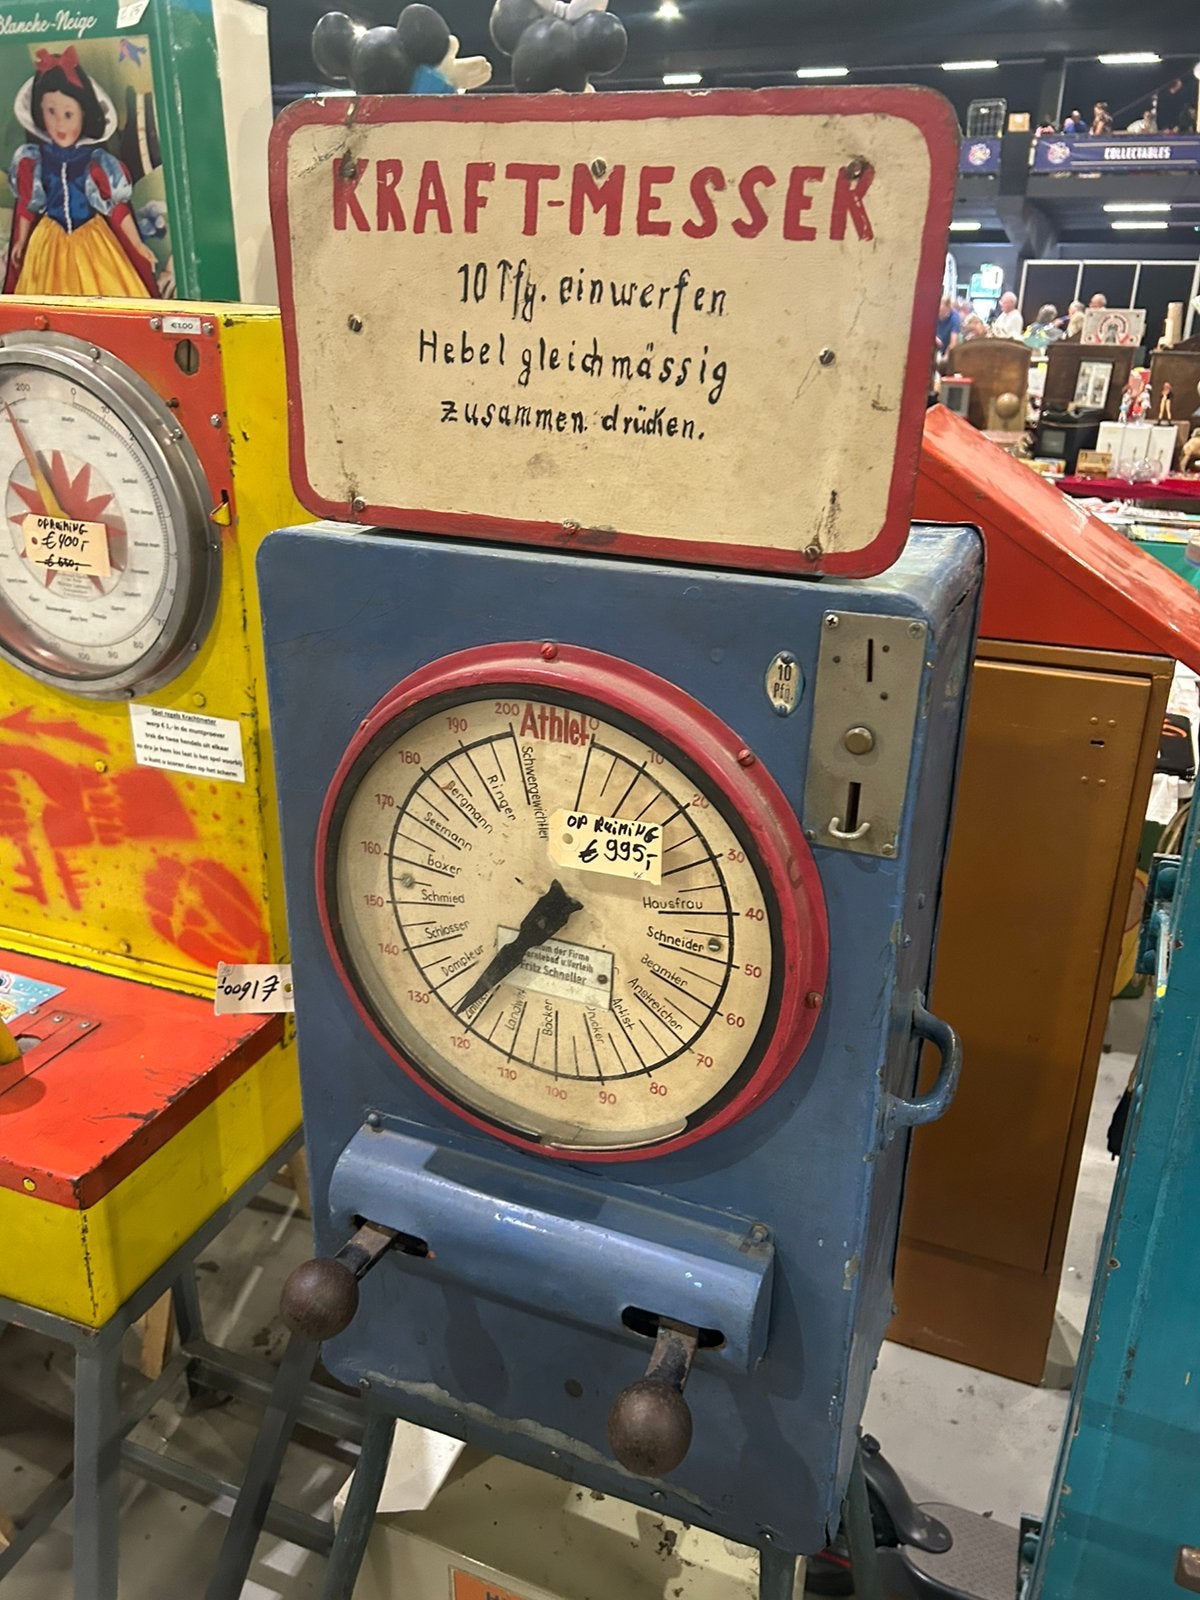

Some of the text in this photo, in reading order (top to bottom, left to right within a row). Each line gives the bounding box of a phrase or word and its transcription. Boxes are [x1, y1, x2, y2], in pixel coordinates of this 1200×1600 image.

[1104, 146, 1171, 159] COLLECTABLES
[332, 157, 876, 241] KRAFT-MESSER
[457, 261, 488, 304] 10
[559, 267, 728, 335] einwerfen
[419, 328, 728, 405] Hebel gleichmässig
[777, 664, 792, 682] 10
[495, 702, 520, 716] 200
[448, 717, 468, 733] 190
[520, 703, 589, 746] Athlet
[399, 751, 421, 765] 180
[648, 750, 665, 765] 10
[375, 794, 394, 809] 170
[487, 774, 516, 821] Ringer
[692, 794, 709, 809] 20
[567, 815, 588, 829] OP
[423, 811, 473, 852] Seemann
[361, 841, 381, 855] 160
[727, 849, 745, 863] 30
[427, 854, 462, 875] Boxer
[363, 894, 384, 907] 150
[421, 889, 465, 904] Schmied
[642, 896, 704, 910] Hausfrau
[745, 908, 765, 921] 40
[424, 919, 470, 940] Schlosser
[646, 925, 705, 953] Schneider
[378, 943, 399, 956] 140
[640, 953, 688, 987] Beamter
[744, 964, 762, 978] 50
[408, 990, 430, 1004] 130
[628, 977, 683, 1031] Anstreicher
[611, 998, 636, 1031] Artist
[726, 1013, 745, 1028] 60
[450, 1036, 471, 1049] 120
[696, 1053, 714, 1068] 70
[497, 1067, 518, 1080] 110
[546, 1085, 568, 1100] 100
[649, 1082, 668, 1096] 80
[599, 1091, 617, 1105] 90
